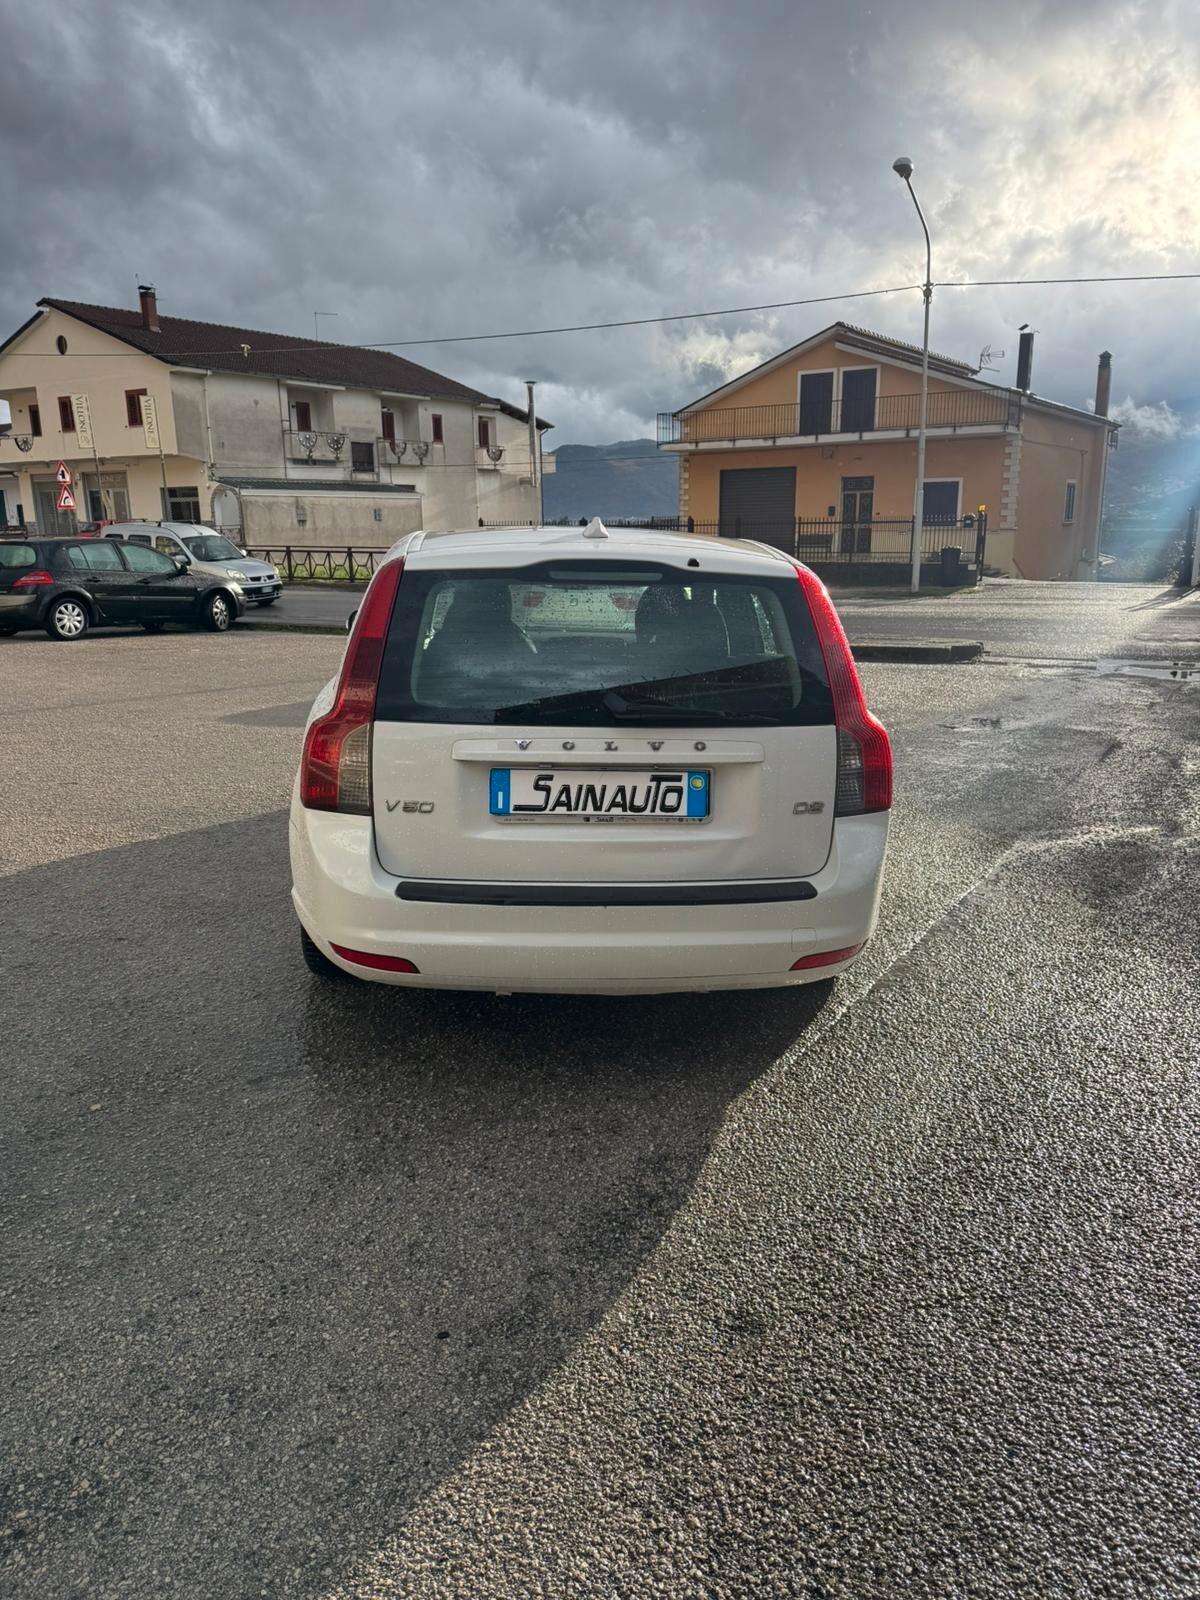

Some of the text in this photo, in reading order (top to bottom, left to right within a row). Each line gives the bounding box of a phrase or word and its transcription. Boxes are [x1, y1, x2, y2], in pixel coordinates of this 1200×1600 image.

[514, 739, 707, 752] VOLVO
[512, 773, 684, 813] SAINAUTO
[385, 799, 435, 814] V50
